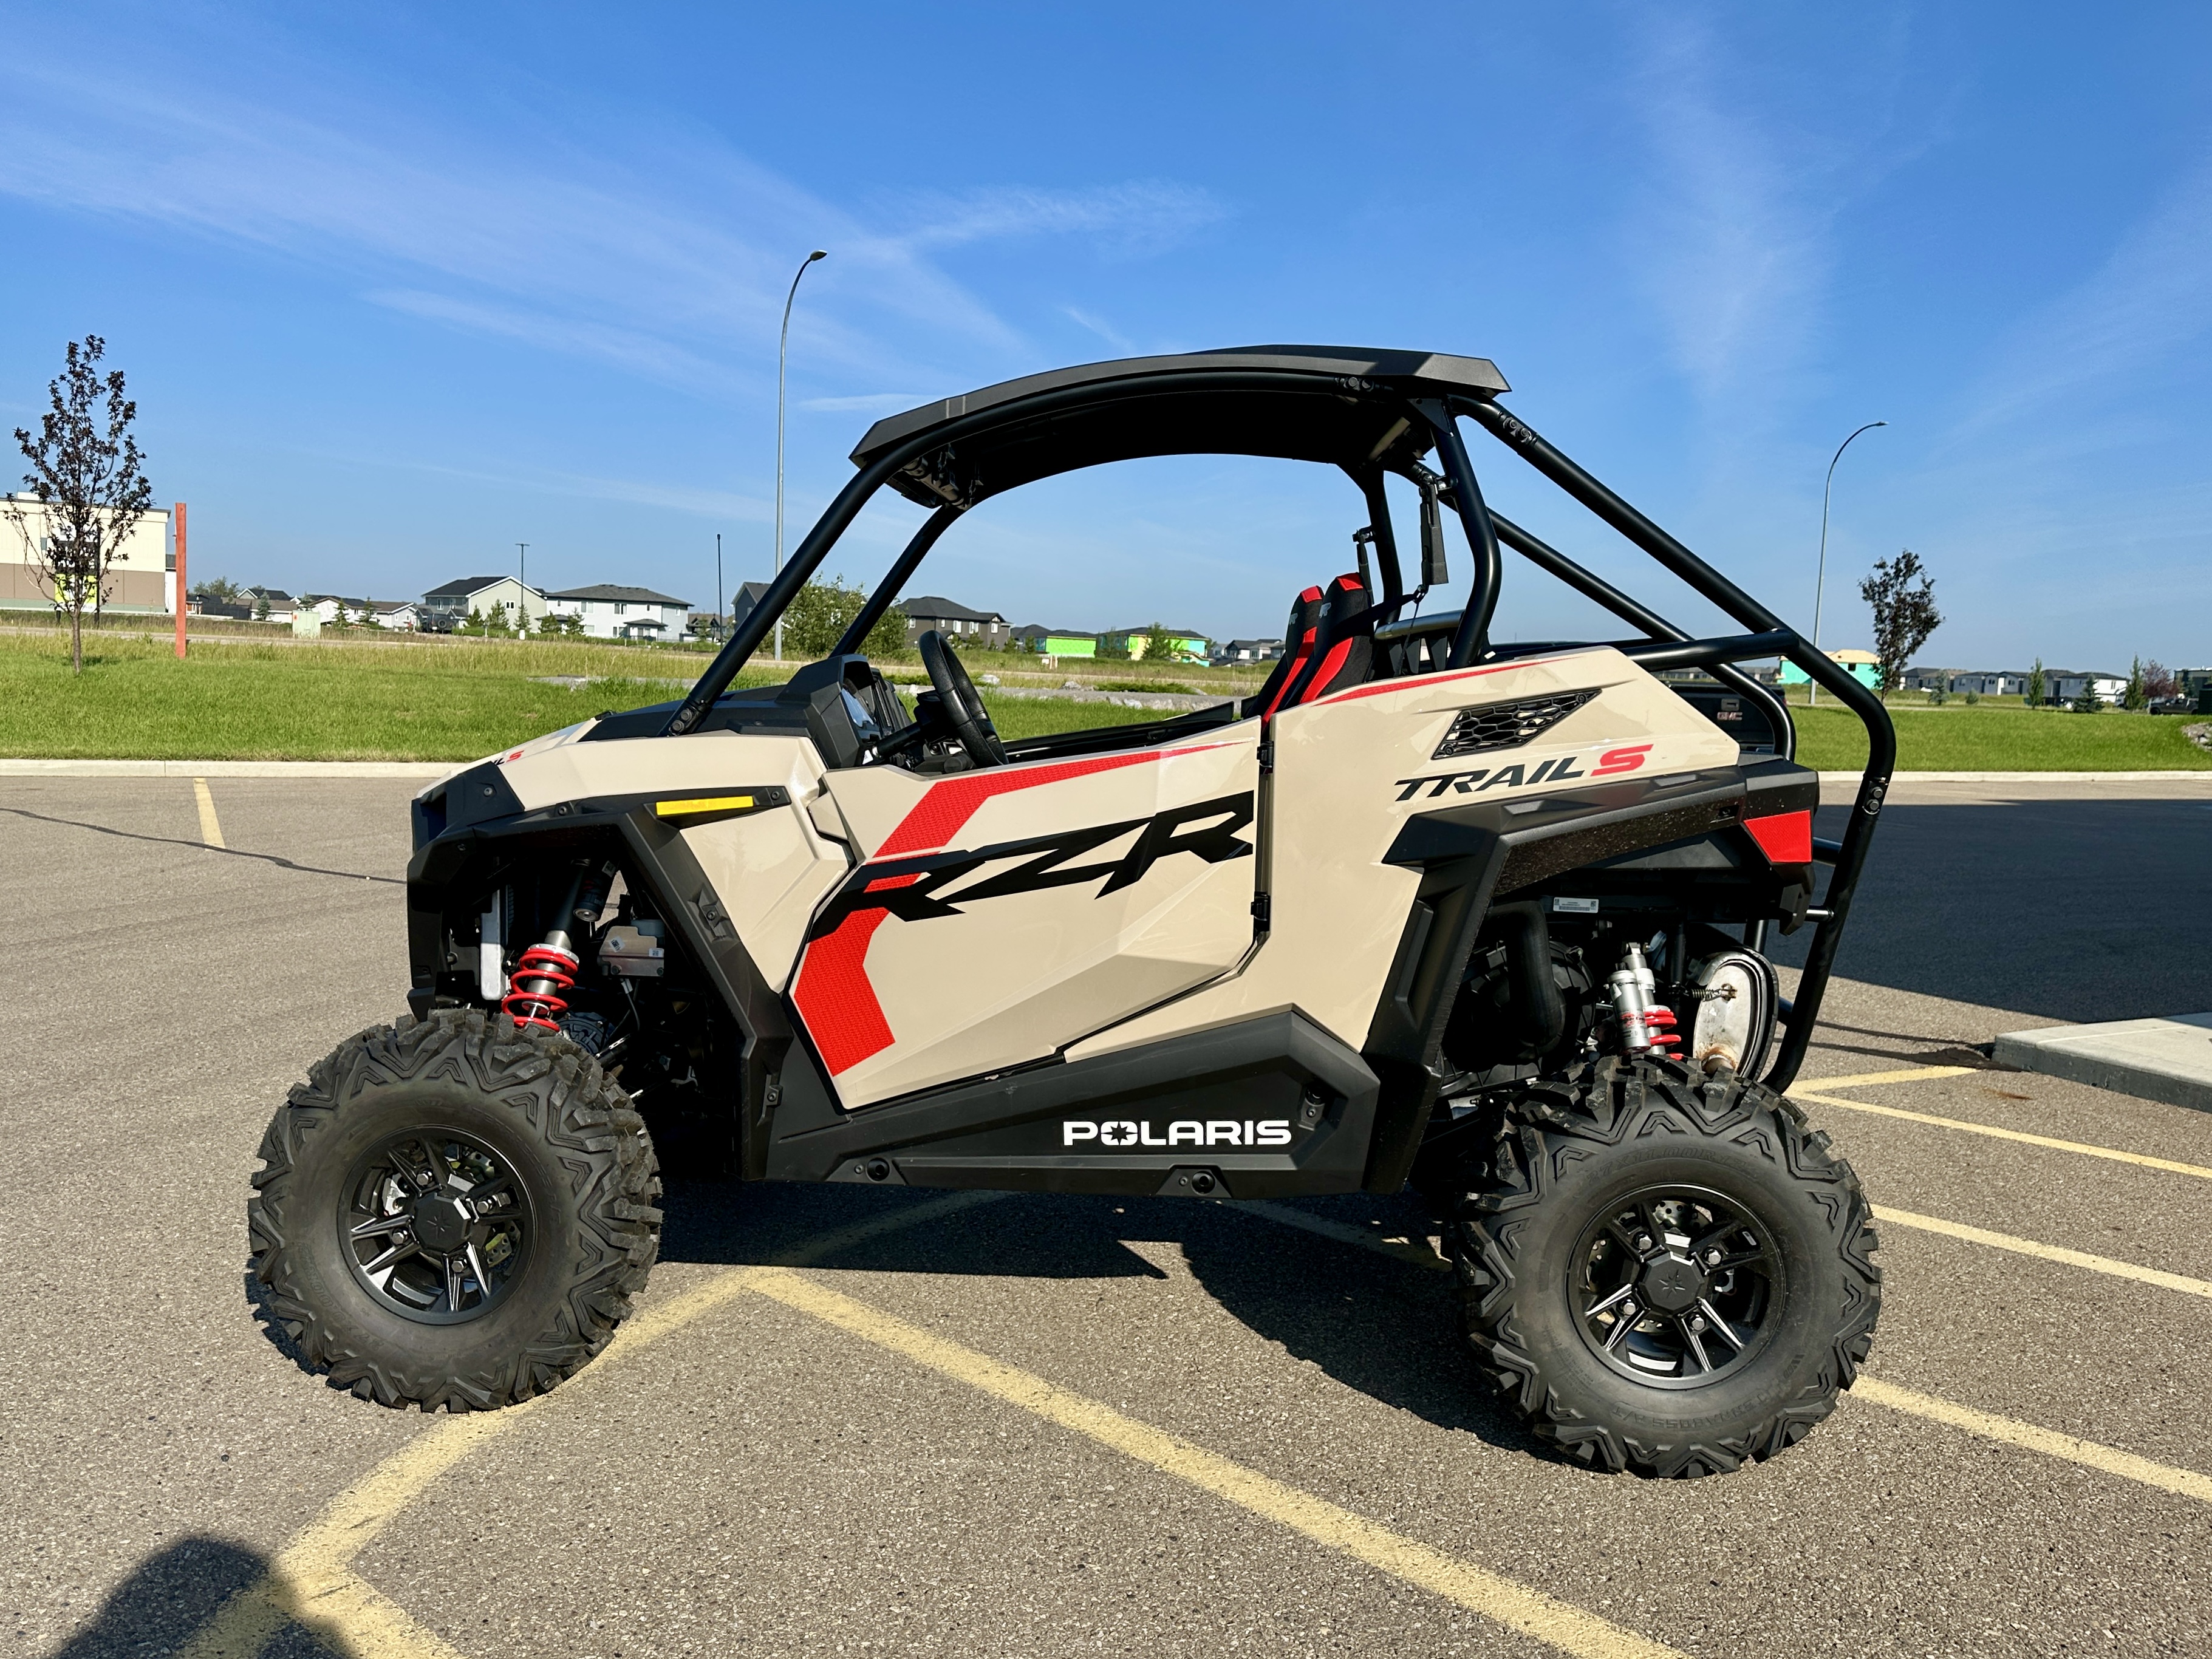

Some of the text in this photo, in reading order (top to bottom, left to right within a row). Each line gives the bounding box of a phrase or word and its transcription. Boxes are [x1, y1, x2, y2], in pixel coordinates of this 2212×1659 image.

[1717, 712, 1743, 721] GMC
[1394, 744, 1654, 802] TRAIL S
[806, 790, 1254, 944] RZR
[1063, 1120, 1292, 1146] POLARIS
